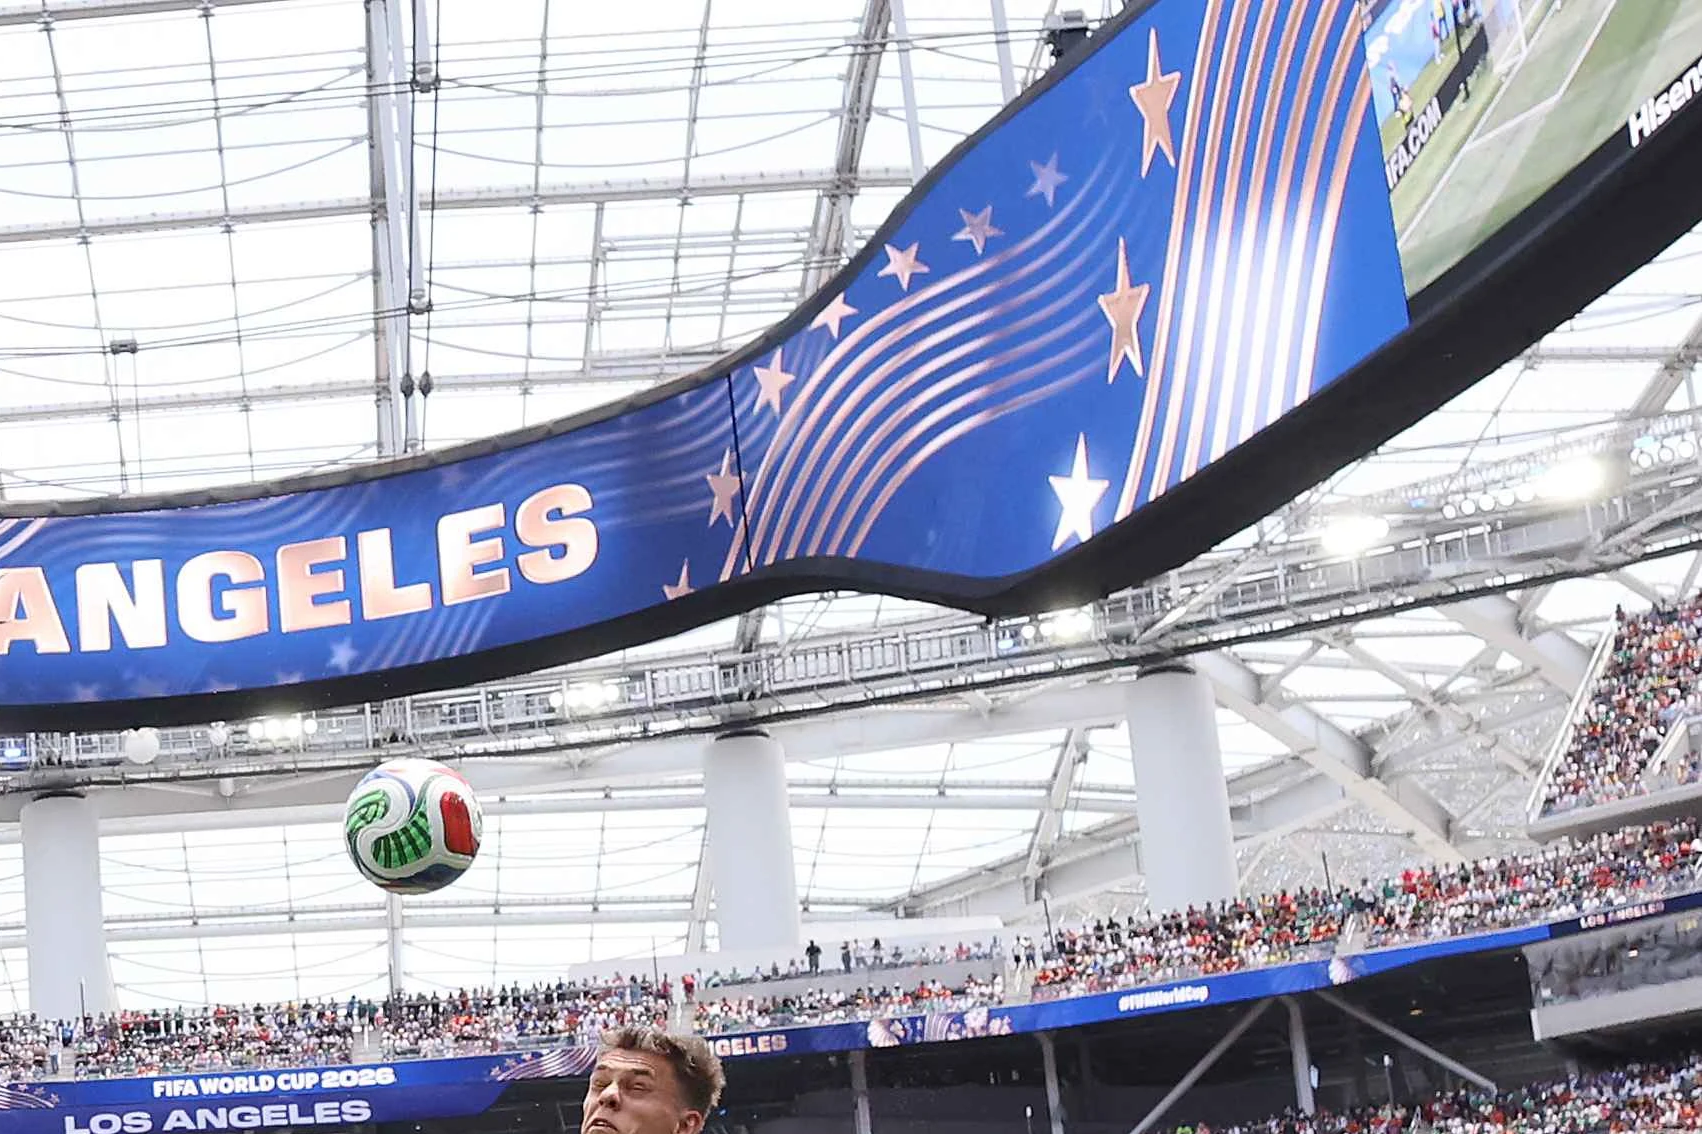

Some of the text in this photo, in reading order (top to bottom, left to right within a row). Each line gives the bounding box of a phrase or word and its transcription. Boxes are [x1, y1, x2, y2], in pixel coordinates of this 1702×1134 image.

[708, 1035, 787, 1057] GELES
[153, 1068, 395, 1098] FIFA WORLD CUP 2026
[162, 1100, 372, 1131] ANGELES
